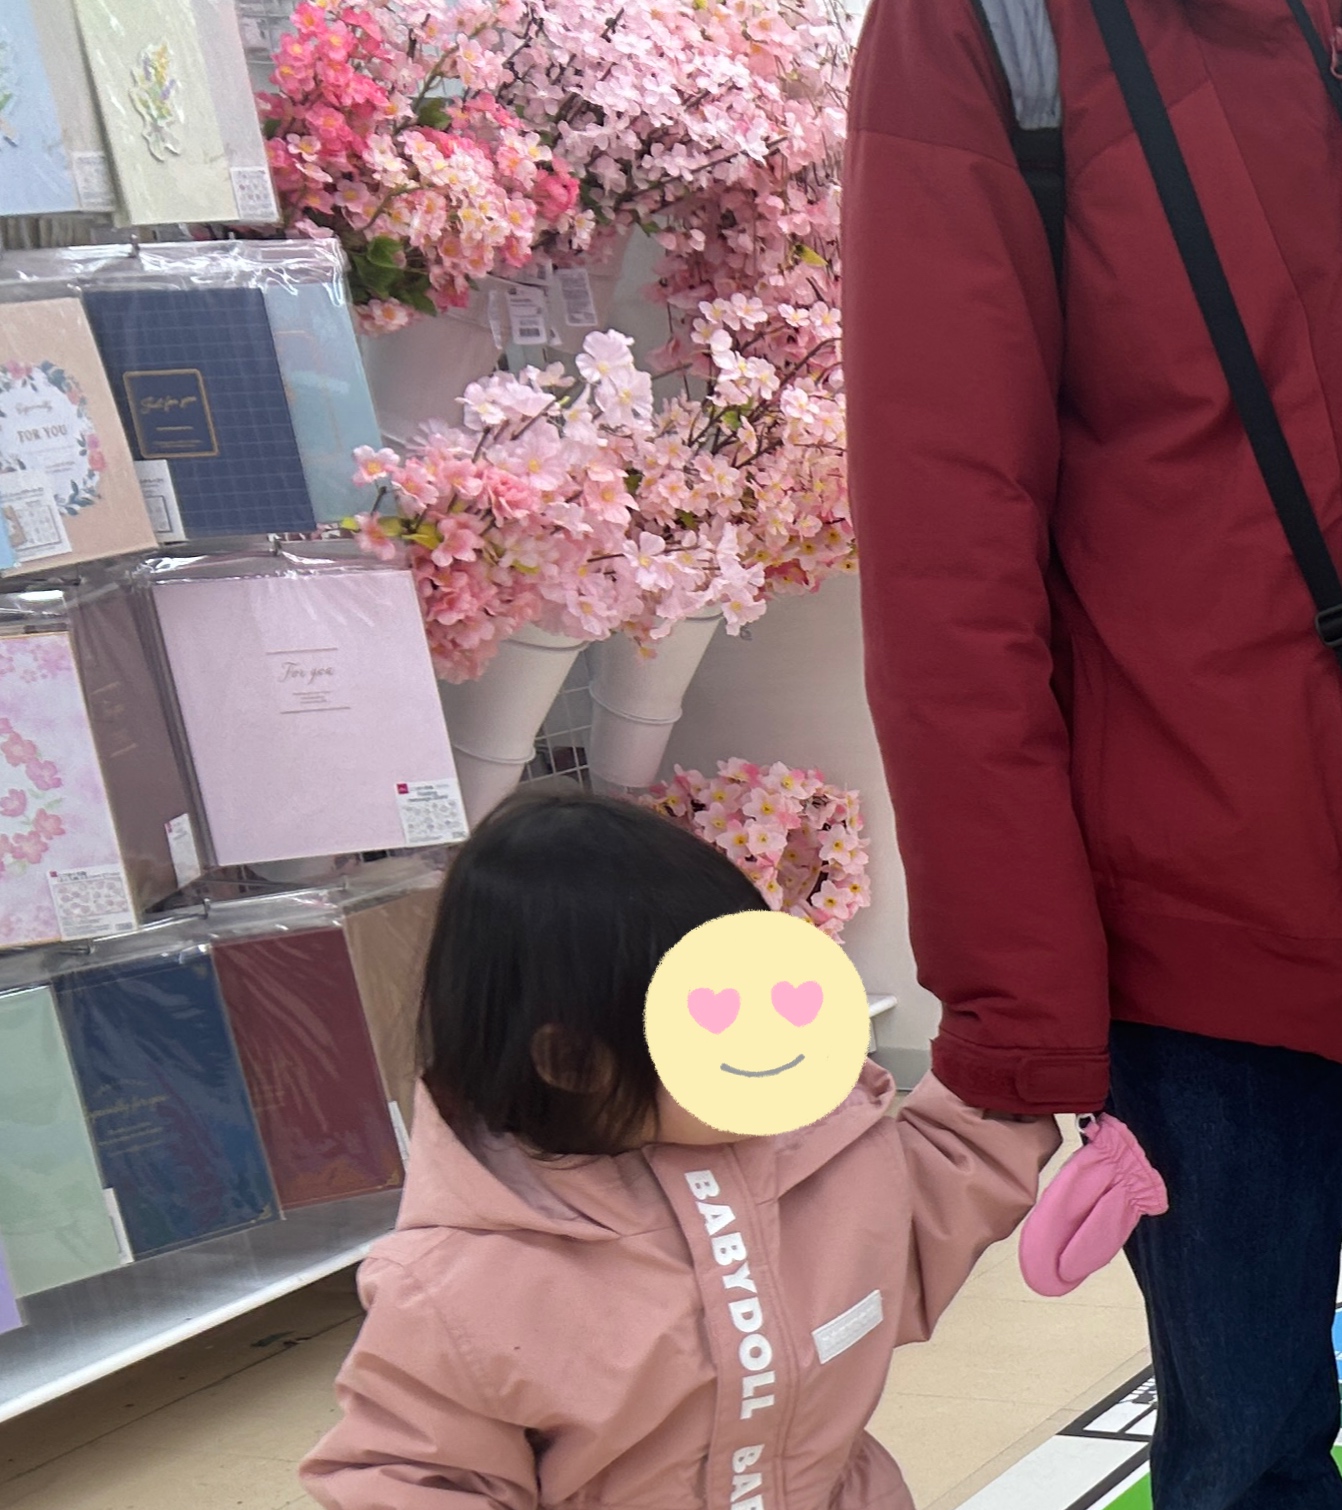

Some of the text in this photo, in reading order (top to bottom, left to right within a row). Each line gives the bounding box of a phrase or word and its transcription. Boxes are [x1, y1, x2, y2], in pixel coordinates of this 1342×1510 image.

[17, 423, 68, 443] FOR YOU
[278, 661, 306, 684] For
[684, 1168, 776, 1421] BABYDOLL
